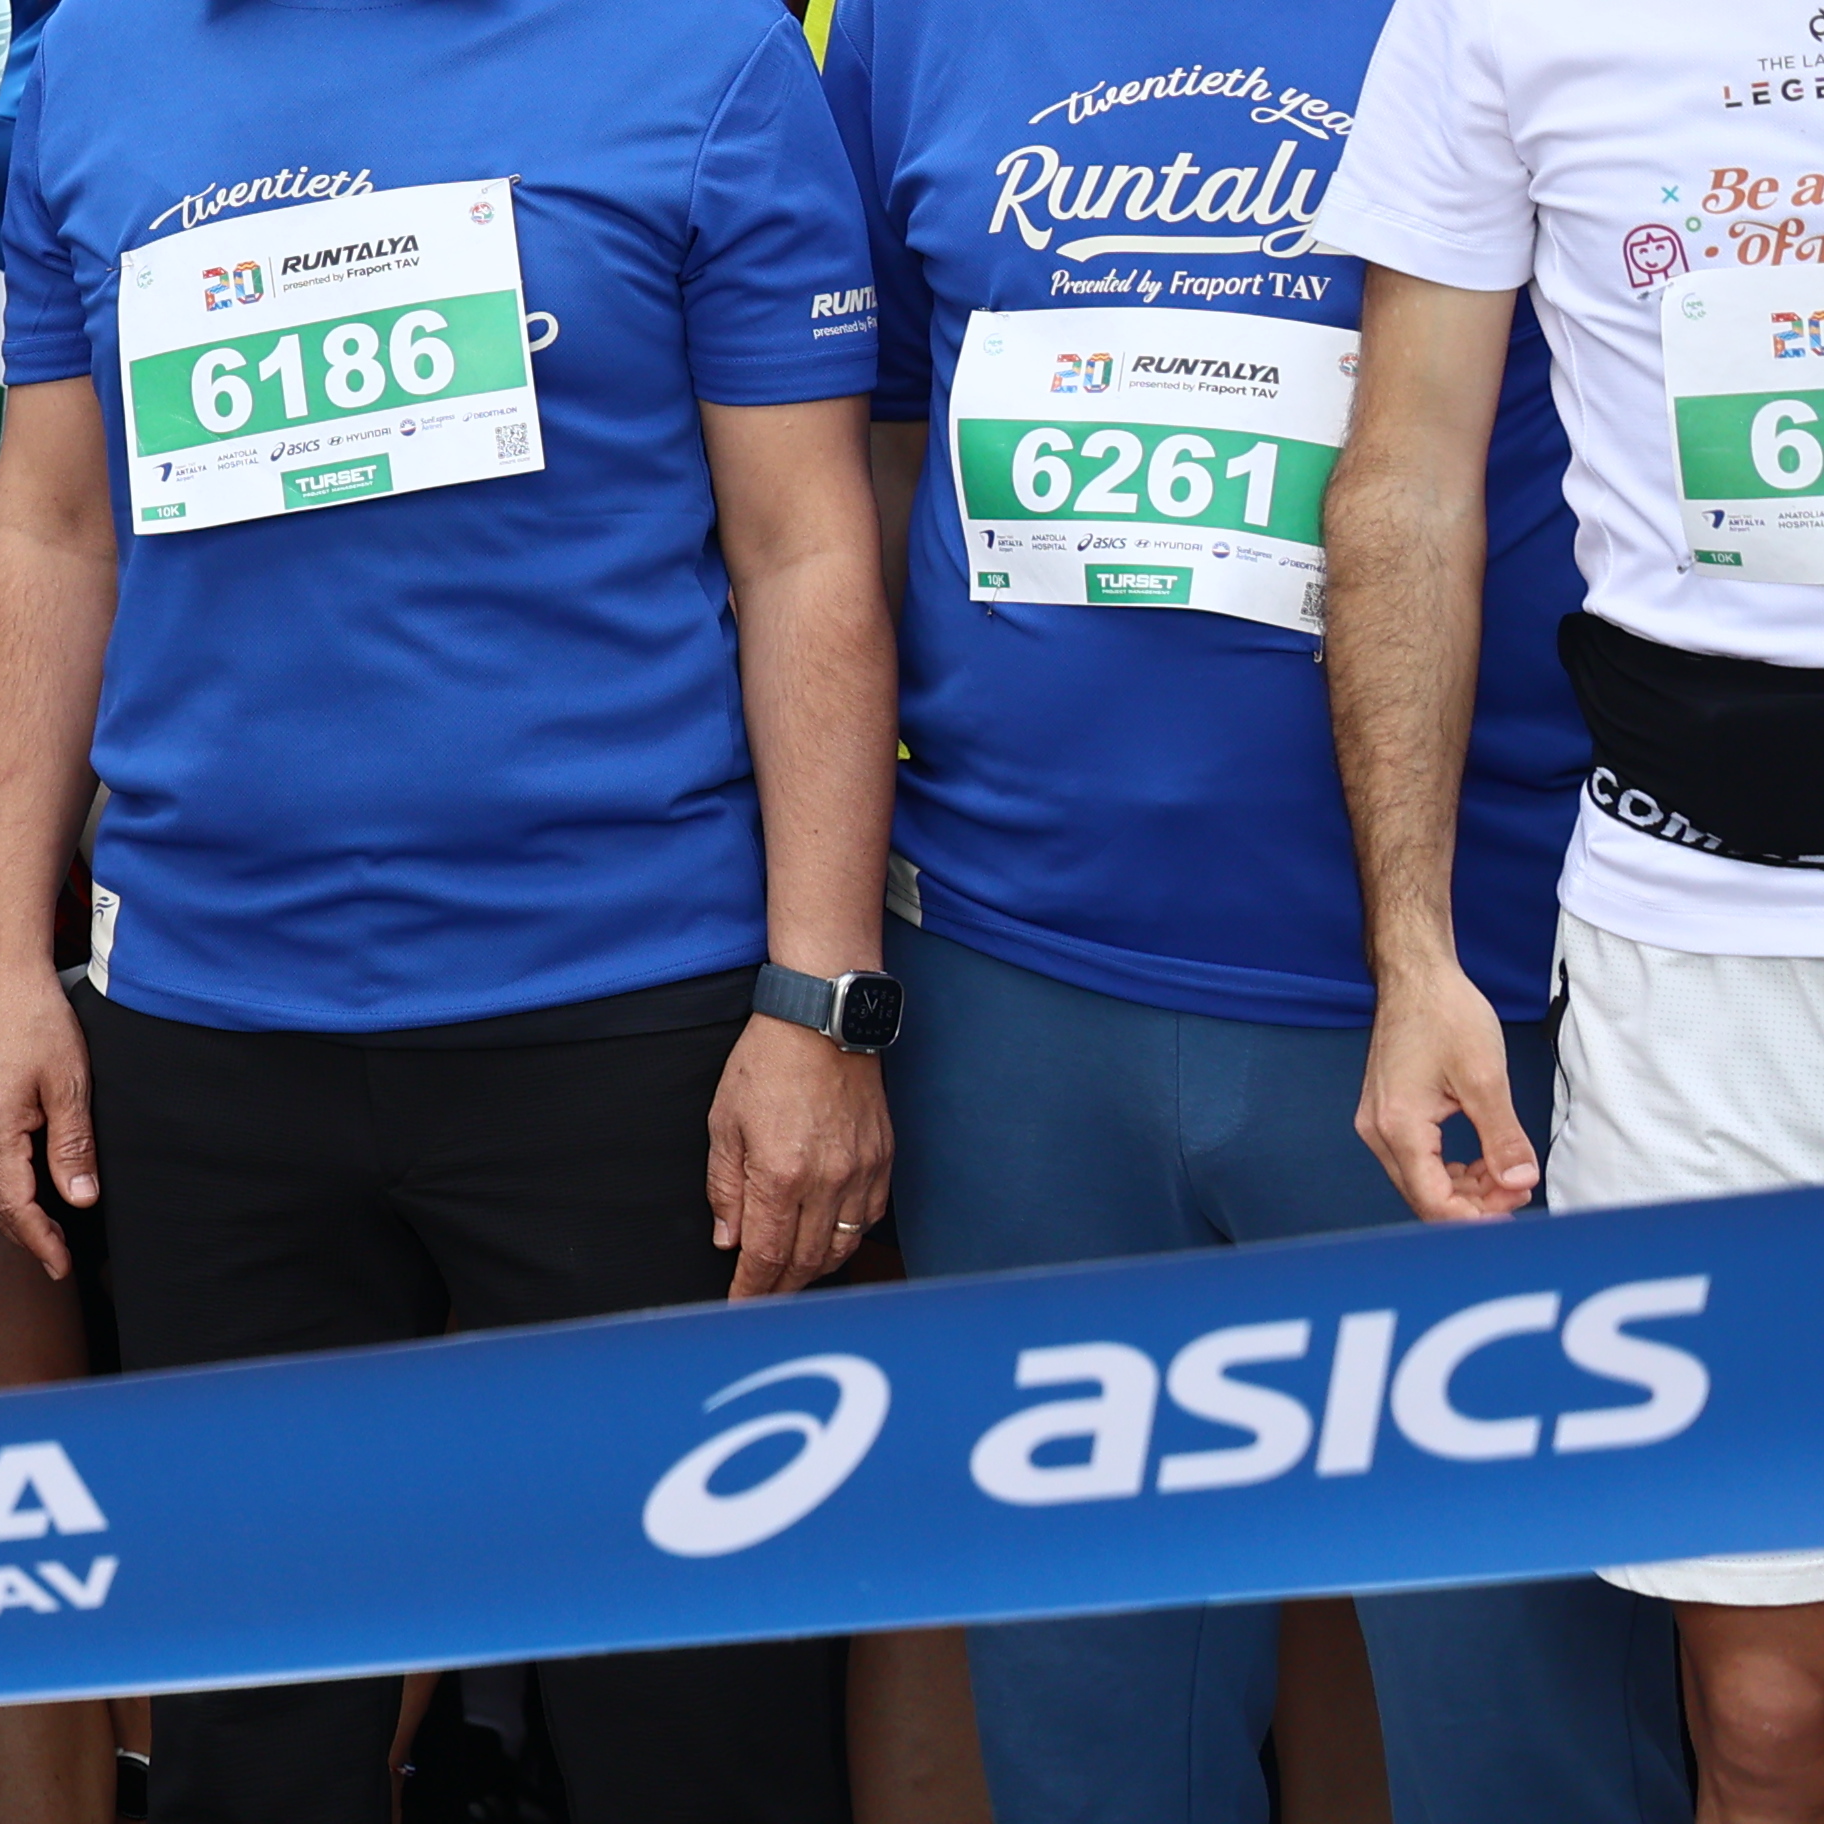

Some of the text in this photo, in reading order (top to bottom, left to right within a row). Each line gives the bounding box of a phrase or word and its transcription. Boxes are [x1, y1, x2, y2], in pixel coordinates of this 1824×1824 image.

[1757, 55, 1795, 72] THE
[1702, 167, 1779, 214] Be
[202, 234, 419, 312] 20 RUNTALYA
[283, 256, 420, 293] presented Fraport TAV
[1051, 269, 1332, 304] Presented by Fraport TAV
[813, 320, 858, 340] presented
[190, 309, 455, 434] 6186
[1050, 352, 1281, 394] 20 RUNTALYA
[1128, 379, 1278, 399] presented Fraport TAV
[346, 427, 392, 443] HYUNDAI
[1752, 398, 1824, 490] 6
[217, 449, 258, 462] ANATOLIA
[217, 457, 259, 471] HOSPITAL
[295, 464, 377, 492] TURSET
[1012, 427, 1278, 527] 6261
[157, 505, 180, 518] 10K
[1032, 533, 1067, 543] ANATOLIA
[1032, 542, 1067, 551] HOSPITAL
[1154, 541, 1202, 552] HYUNDAI
[1710, 553, 1735, 564] 10K
[988, 574, 1006, 587] 10K
[1096, 573, 1178, 590] TURSET
